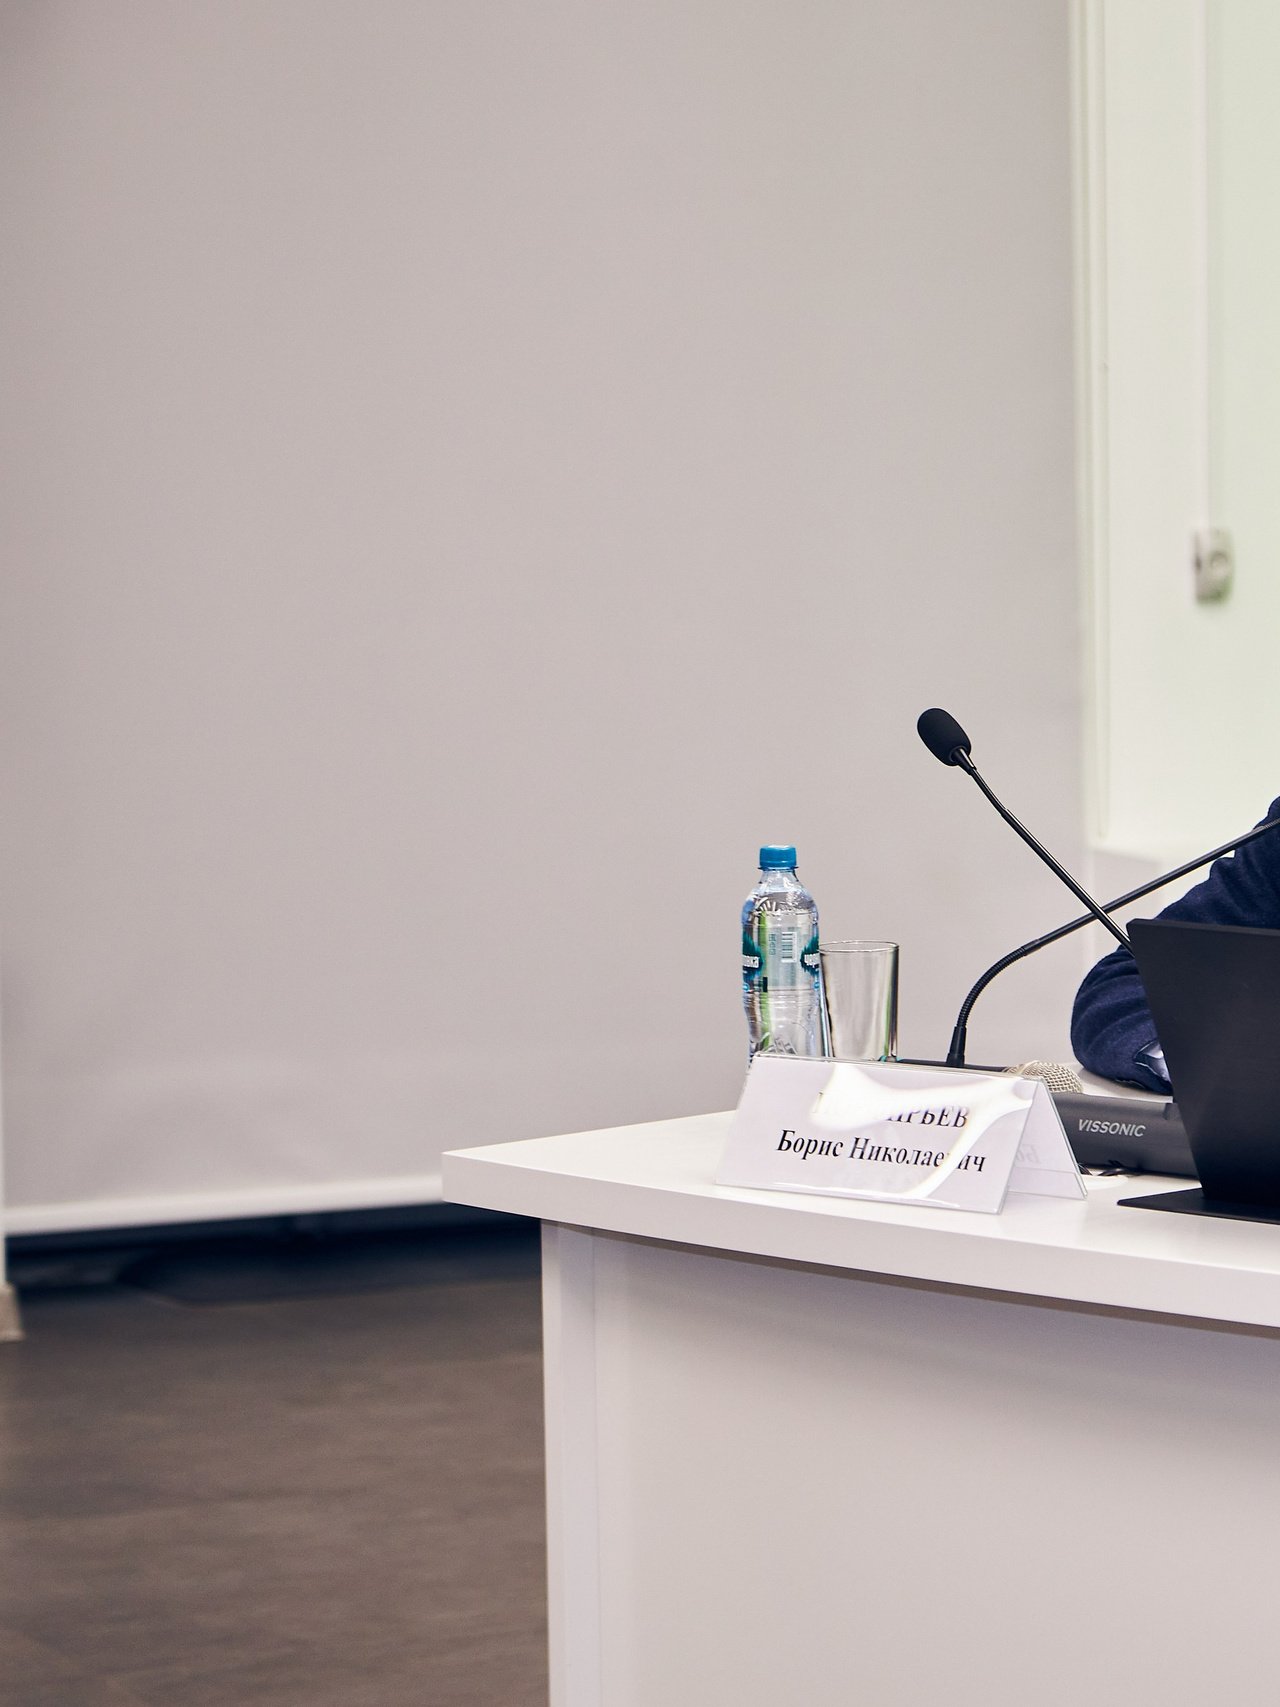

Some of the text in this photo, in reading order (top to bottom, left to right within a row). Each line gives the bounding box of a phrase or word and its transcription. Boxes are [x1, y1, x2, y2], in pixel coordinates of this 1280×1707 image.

[1078, 1118, 1146, 1137] VISSONIC
[776, 1129, 844, 1160] Борис
[849, 1136, 986, 1173] Николаеич
